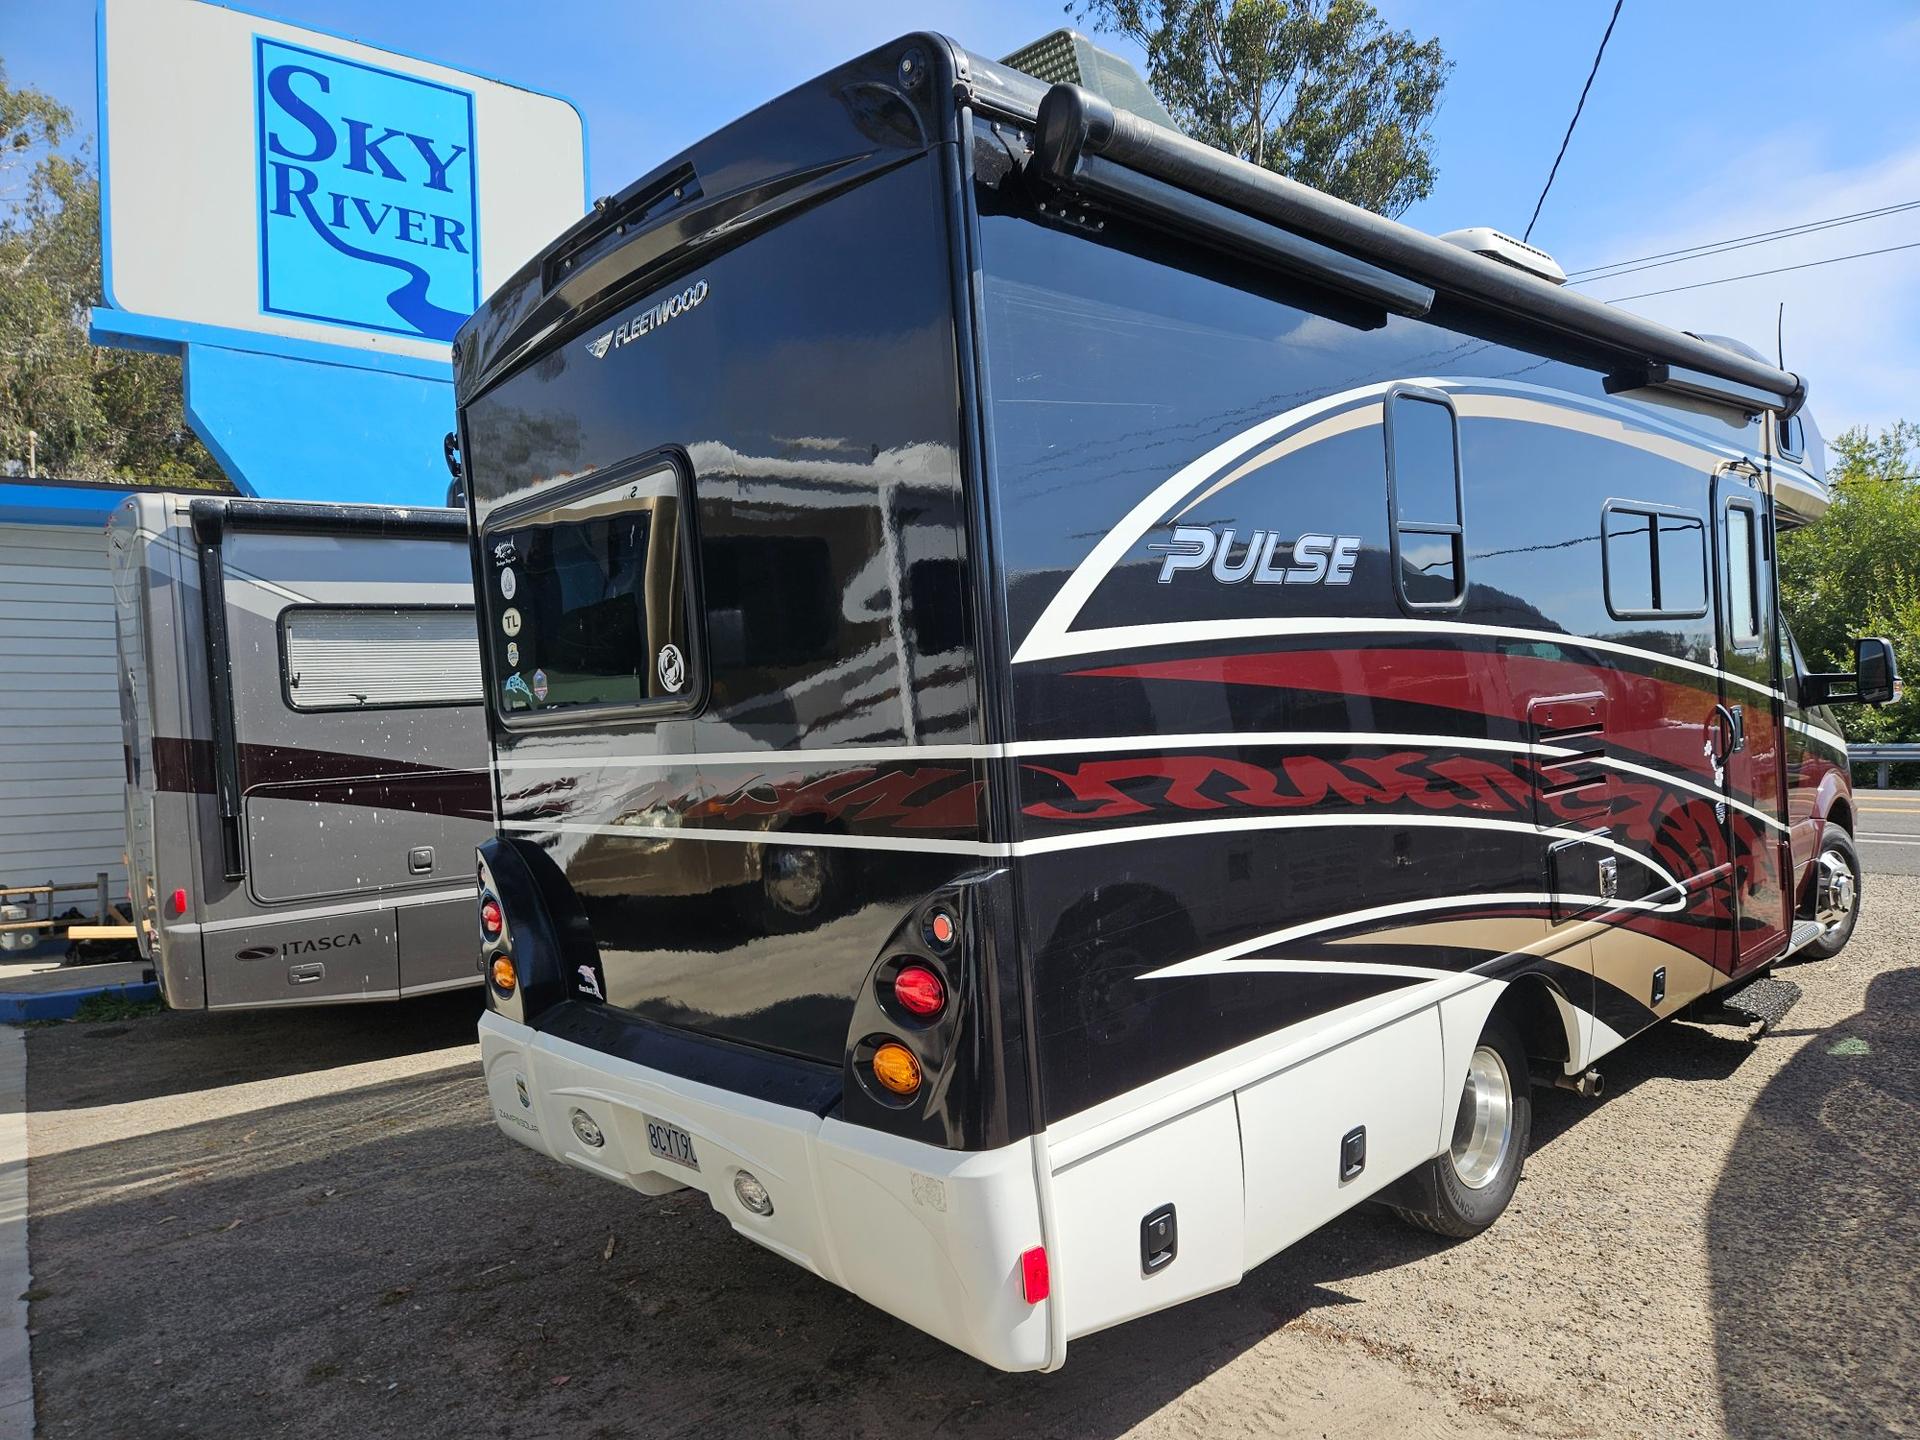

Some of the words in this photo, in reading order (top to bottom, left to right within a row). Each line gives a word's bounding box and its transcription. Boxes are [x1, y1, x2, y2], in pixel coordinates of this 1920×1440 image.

[268, 64, 466, 193] SKY
[269, 160, 469, 254] RIVER
[615, 279, 709, 348] FLEETWOOD
[1148, 526, 1362, 586] PULSE
[505, 615, 519, 629] TL
[282, 933, 362, 956] ITASCA
